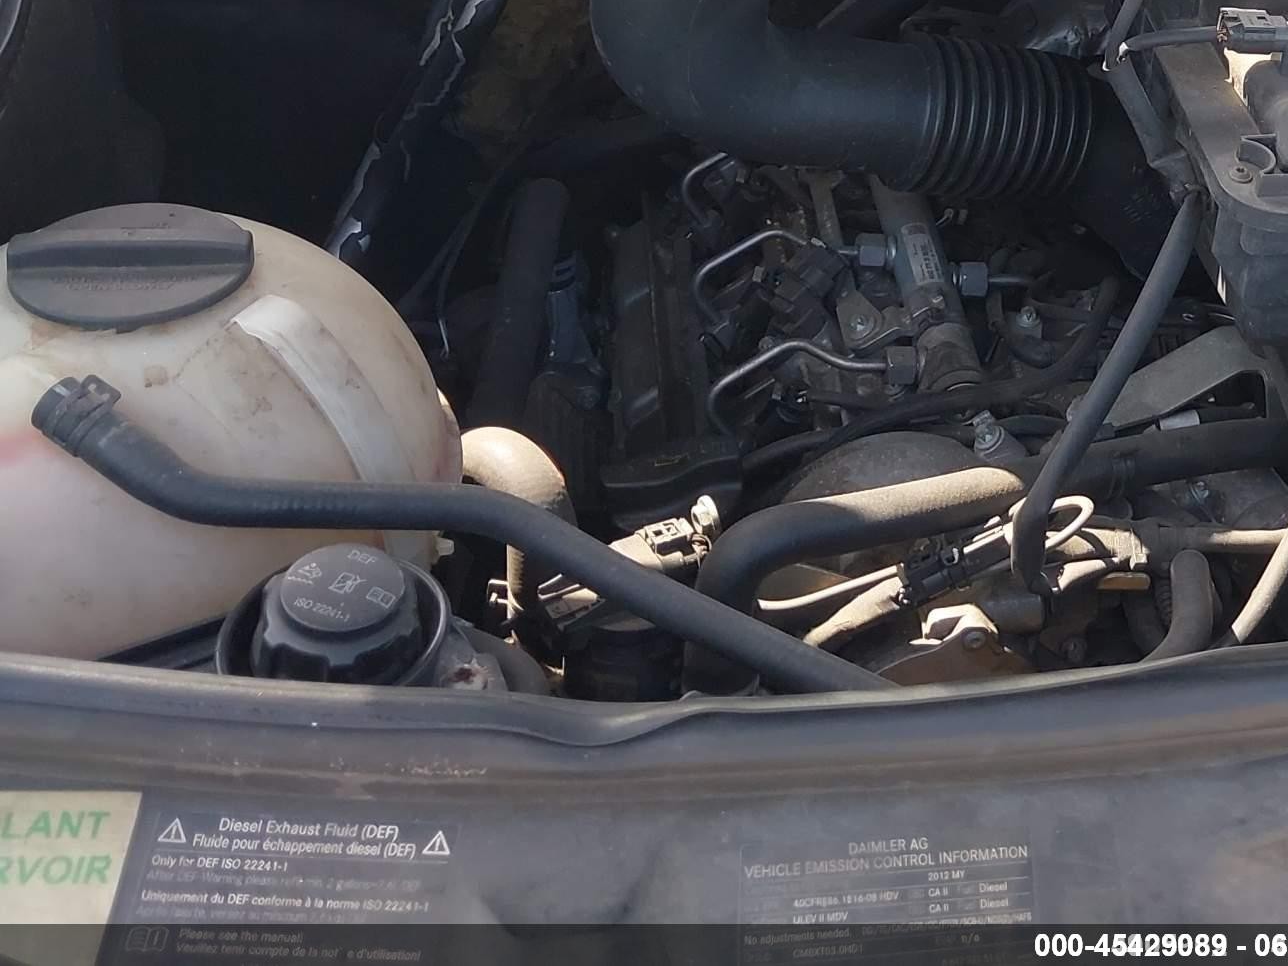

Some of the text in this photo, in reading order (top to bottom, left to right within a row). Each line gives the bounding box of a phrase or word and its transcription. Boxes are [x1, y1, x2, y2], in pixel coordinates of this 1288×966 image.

[347, 549, 378, 564] DEF
[294, 597, 350, 622] ISO 22241-1
[219, 817, 399, 842] Diesel Exhaust Fluid (DEF)
[192, 833, 416, 860] Fluide pour échappement diesel (DEF)
[848, 837, 928, 855] DAIMLER AG
[151, 854, 288, 872] Only for DEF ISO 22241-1
[744, 845, 1028, 878] VEHICLE EMISSION CONTROL INFORMATION
[928, 870, 965, 881] 2012 MY
[928, 887, 941, 897] CA
[979, 882, 1008, 893] Diesel
[141, 889, 208, 903] Uniquement
[210, 892, 224, 904] du
[227, 893, 250, 905] DEF
[251, 895, 302, 907] conforme
[314, 897, 324, 908] la
[326, 899, 360, 910] norme
[362, 899, 382, 911] ISO
[929, 903, 942, 914] CA
[980, 898, 1009, 909] Diesel
